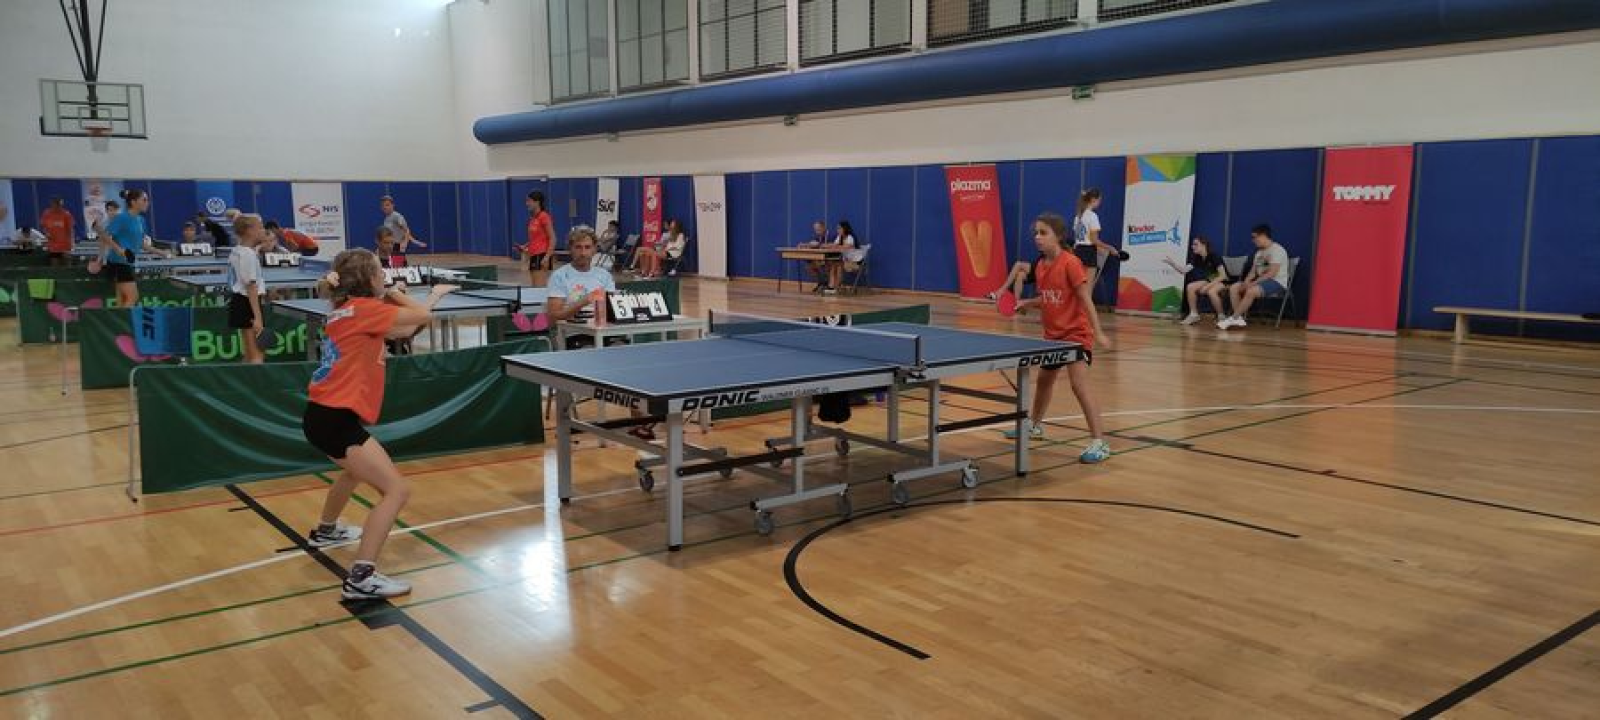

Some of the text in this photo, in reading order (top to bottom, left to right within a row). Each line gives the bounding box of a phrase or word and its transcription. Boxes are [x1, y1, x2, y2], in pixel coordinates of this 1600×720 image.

[951, 178, 991, 194] plazma
[1333, 185, 1395, 200] TOMMY
[617, 300, 626, 317] 5
[653, 298, 662, 313] 4
[1018, 351, 1069, 367] DONIC
[594, 388, 641, 409] DONIC
[682, 391, 760, 410] DONIC
